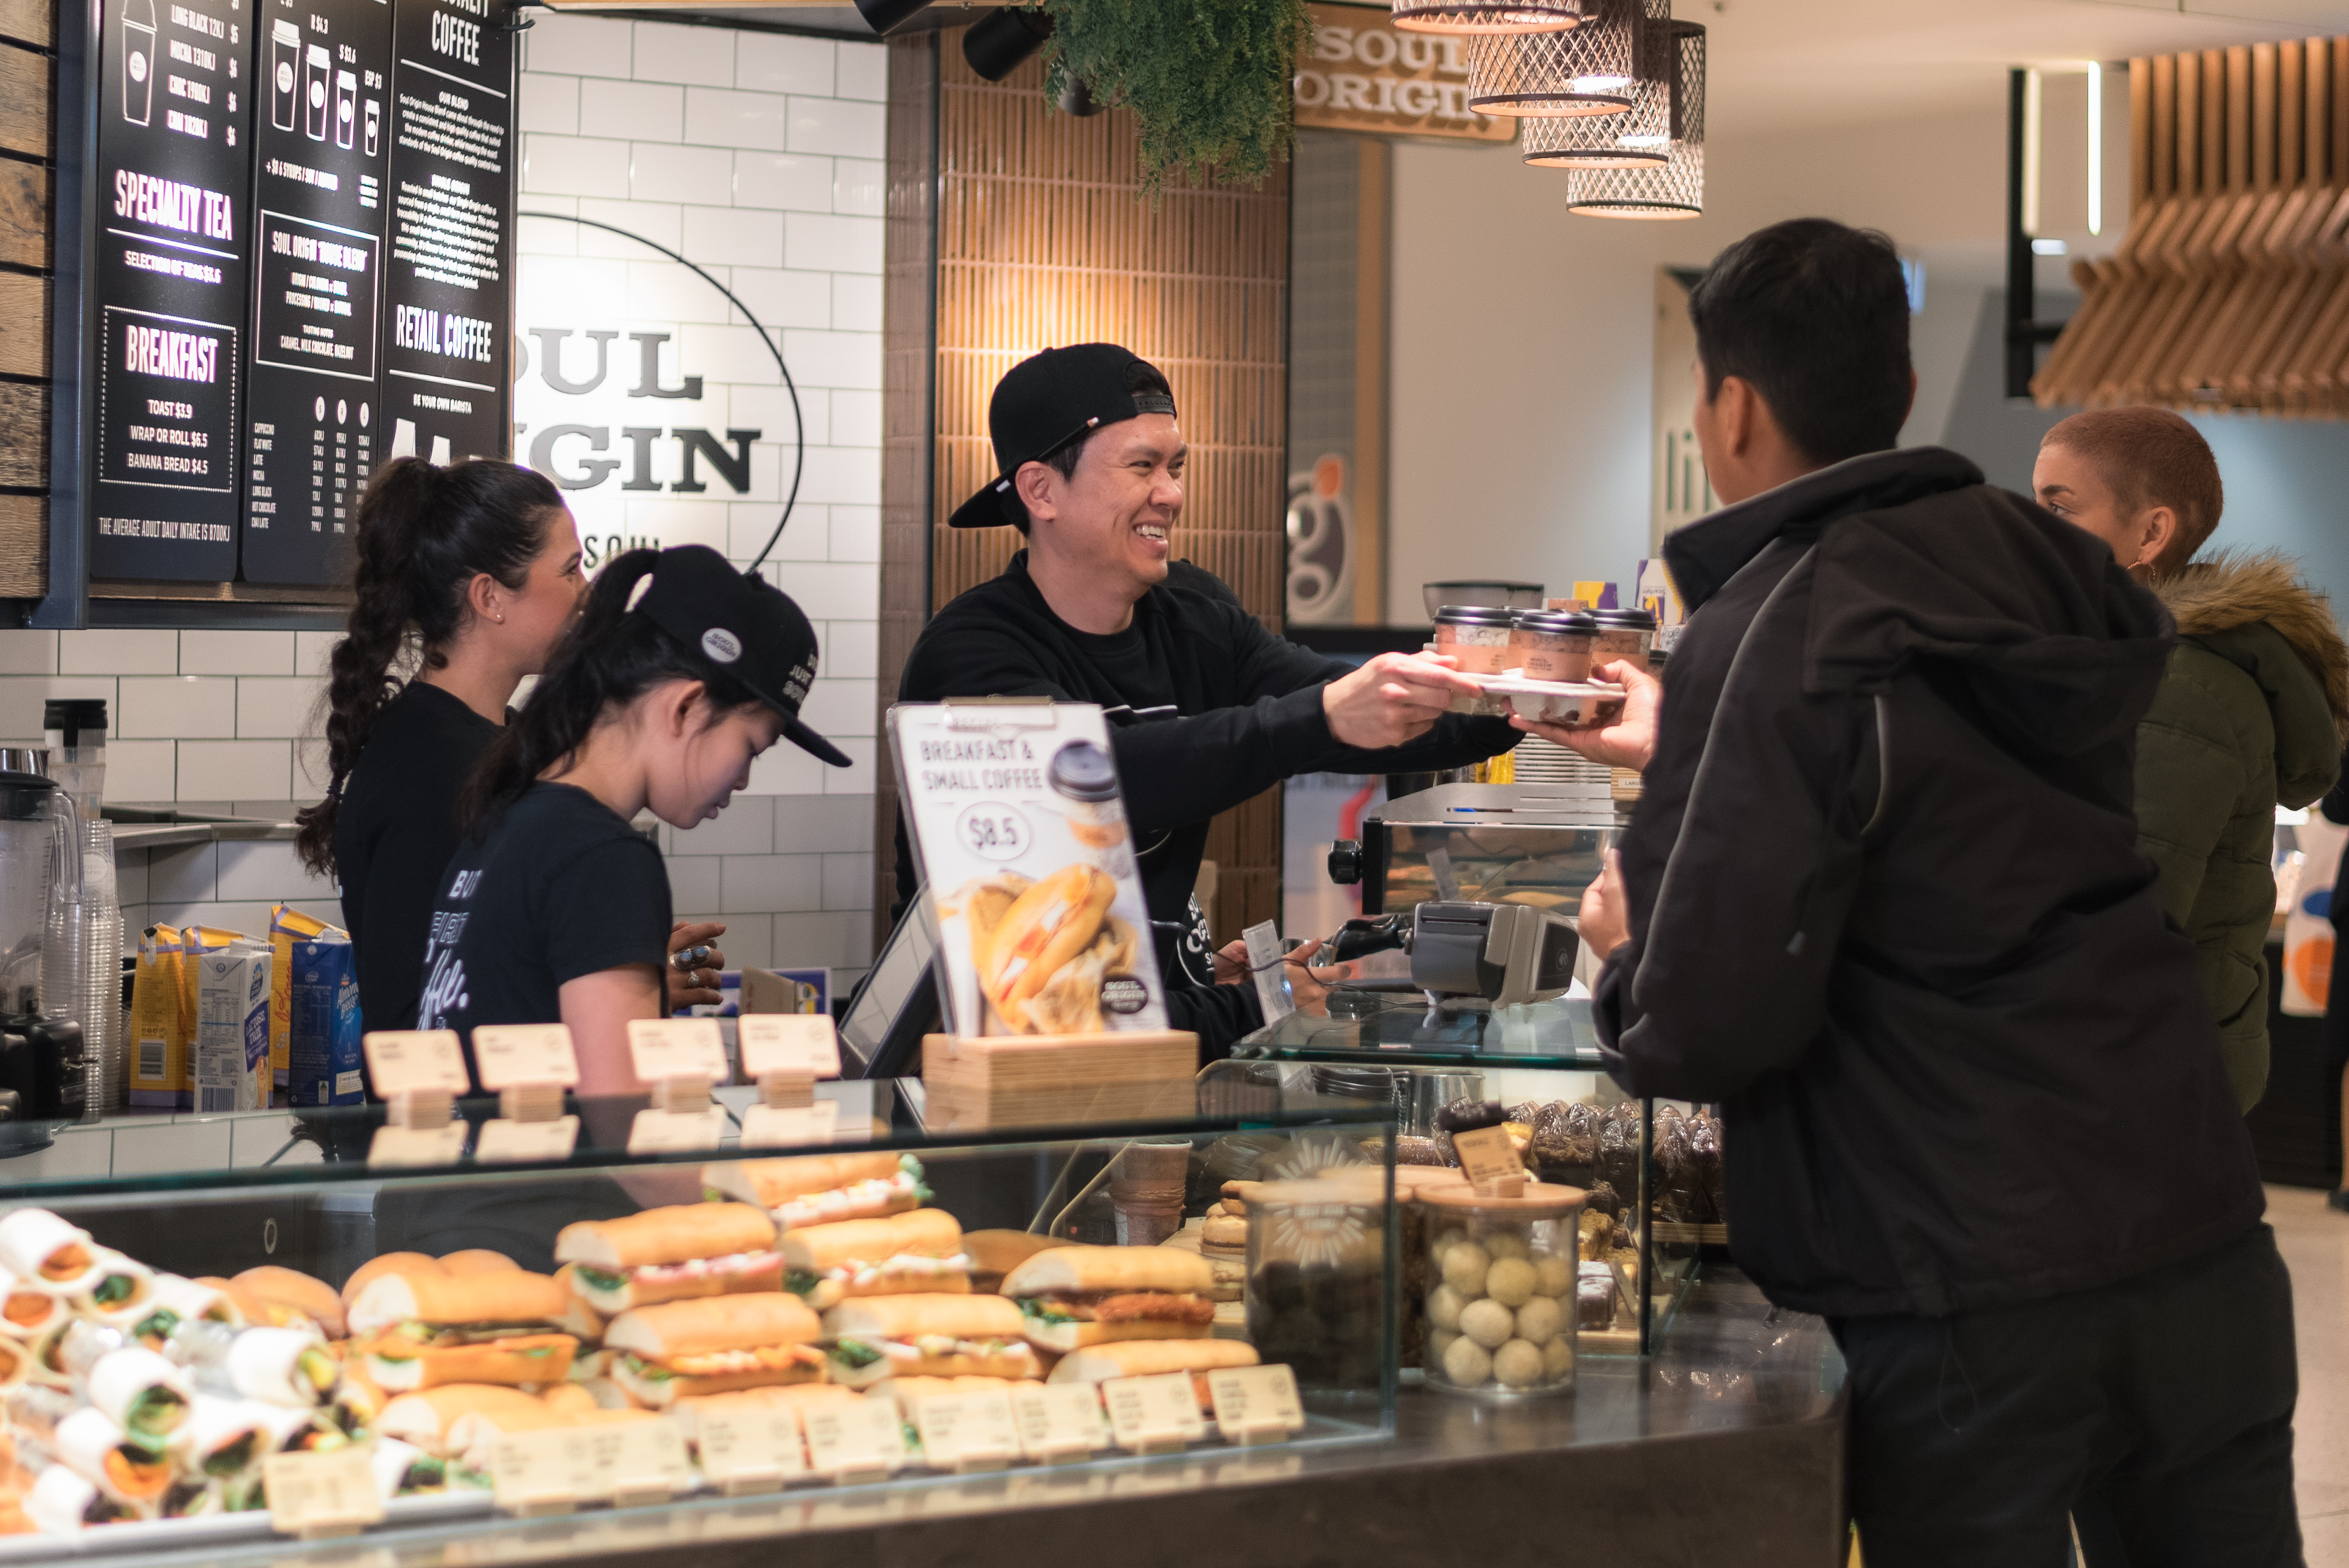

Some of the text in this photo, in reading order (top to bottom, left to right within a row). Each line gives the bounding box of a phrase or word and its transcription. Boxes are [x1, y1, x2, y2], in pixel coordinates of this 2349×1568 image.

[432, 10, 480, 66] COFFEE
[1313, 26, 1469, 74] SOUL
[115, 169, 232, 240] SPECIALTY TEA
[273, 231, 291, 256] SOUL
[125, 250, 170, 274] SELECTION
[395, 304, 493, 363] RETAIL COFFEE
[126, 325, 218, 383] BREAKFAST
[514, 328, 703, 400] UL
[147, 399, 193, 419] TOAST $3.9
[413, 393, 421, 407] BE
[422, 394, 437, 410] YOUR
[436, 397, 450, 411] OWN
[129, 425, 208, 448] WRAP OR ROLL $6.5
[128, 452, 208, 475] BANANA BREAD $4.5
[514, 423, 762, 494] GIN
[99, 517, 230, 542] THE AVERAGE ADULT DAILY INTAKE IS 8700KJ
[921, 739, 1034, 761] BREAKFAST &
[923, 768, 1043, 790] SMALL COFFEE
[969, 814, 1017, 850] $8.5
[448, 869, 483, 899] BUT
[1101, 989, 1146, 1001] ORIGIN
[1105, 981, 1140, 991] SOUL
[246, 1010, 266, 1036] LACTOSE
[249, 1025, 262, 1045] FREE
